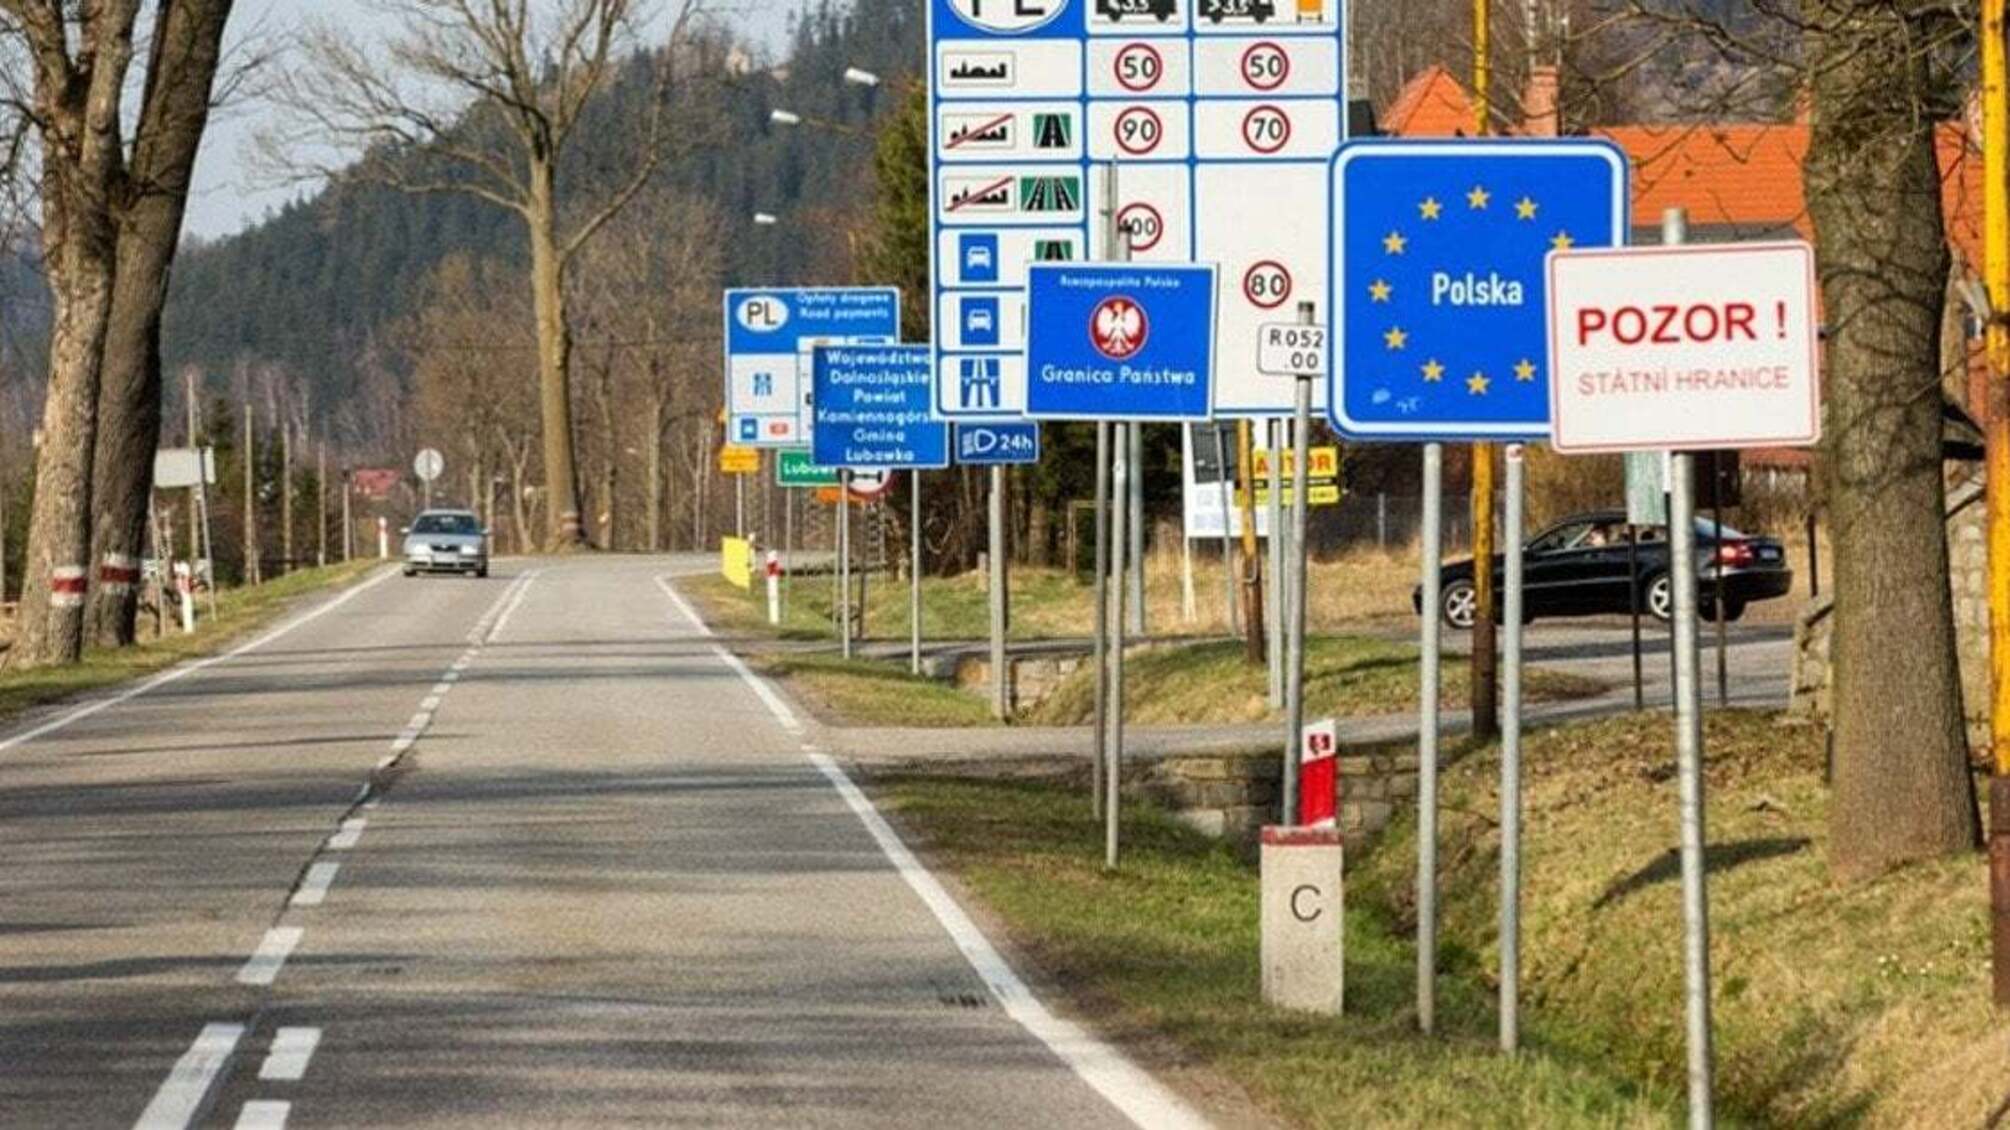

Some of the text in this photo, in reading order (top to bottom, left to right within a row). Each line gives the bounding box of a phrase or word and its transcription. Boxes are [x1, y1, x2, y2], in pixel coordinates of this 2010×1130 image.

[1124, 55, 1155, 79] 50
[1250, 54, 1283, 78] 50
[1123, 118, 1154, 143] 90
[1254, 117, 1283, 141] 70
[1251, 274, 1285, 297] 80
[1432, 273, 1524, 306] Polska
[747, 302, 776, 326] PL
[1578, 302, 1786, 346] POZOR !
[1042, 364, 1196, 385] Granica Państwa
[1675, 365, 1790, 391] HRANICE
[853, 388, 907, 403] Powiat
[853, 428, 905, 442] Gmina
[1000, 434, 1033, 450] 24h
[845, 448, 915, 462] Lubawka
[783, 461, 837, 475] Lubaw
[1291, 884, 1322, 922] C
